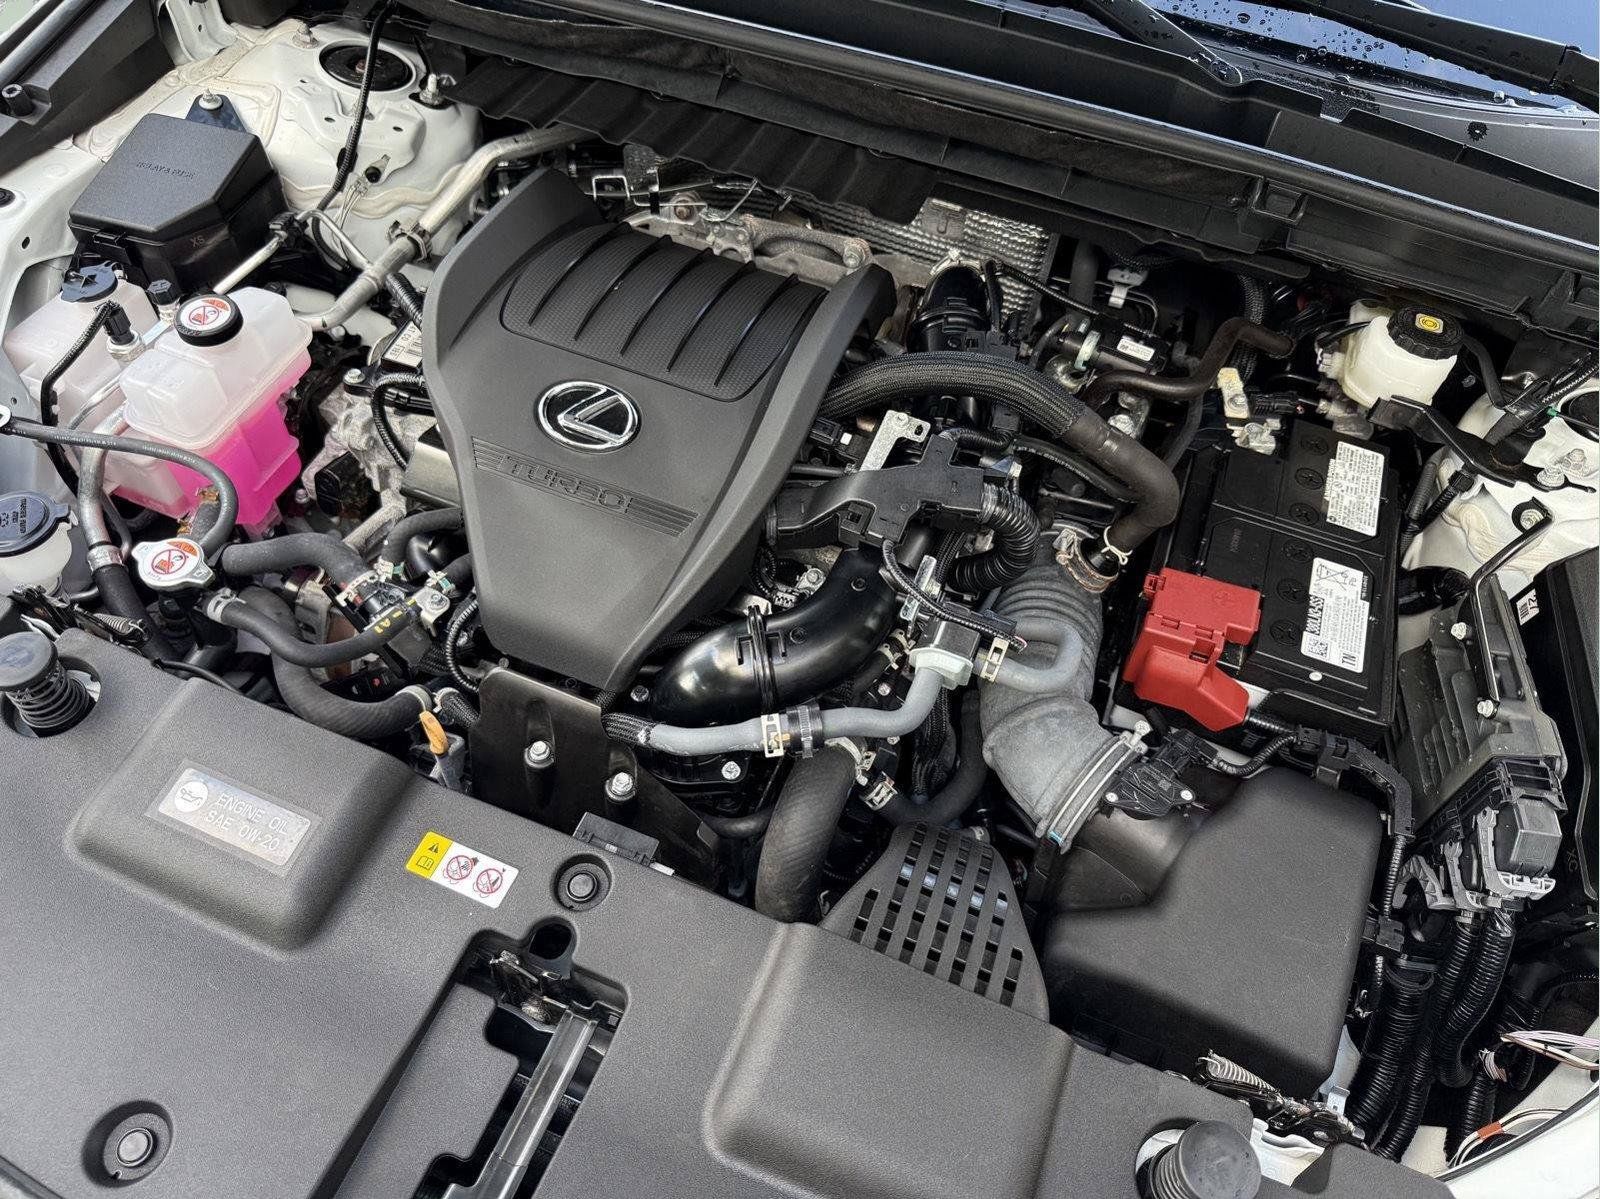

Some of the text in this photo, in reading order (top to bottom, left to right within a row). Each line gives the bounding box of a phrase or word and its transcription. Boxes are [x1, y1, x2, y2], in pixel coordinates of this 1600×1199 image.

[498, 453, 626, 511] TURBO
[205, 810, 280, 852] SAE 0W-20
[215, 793, 288, 835] ENGINE OIL
